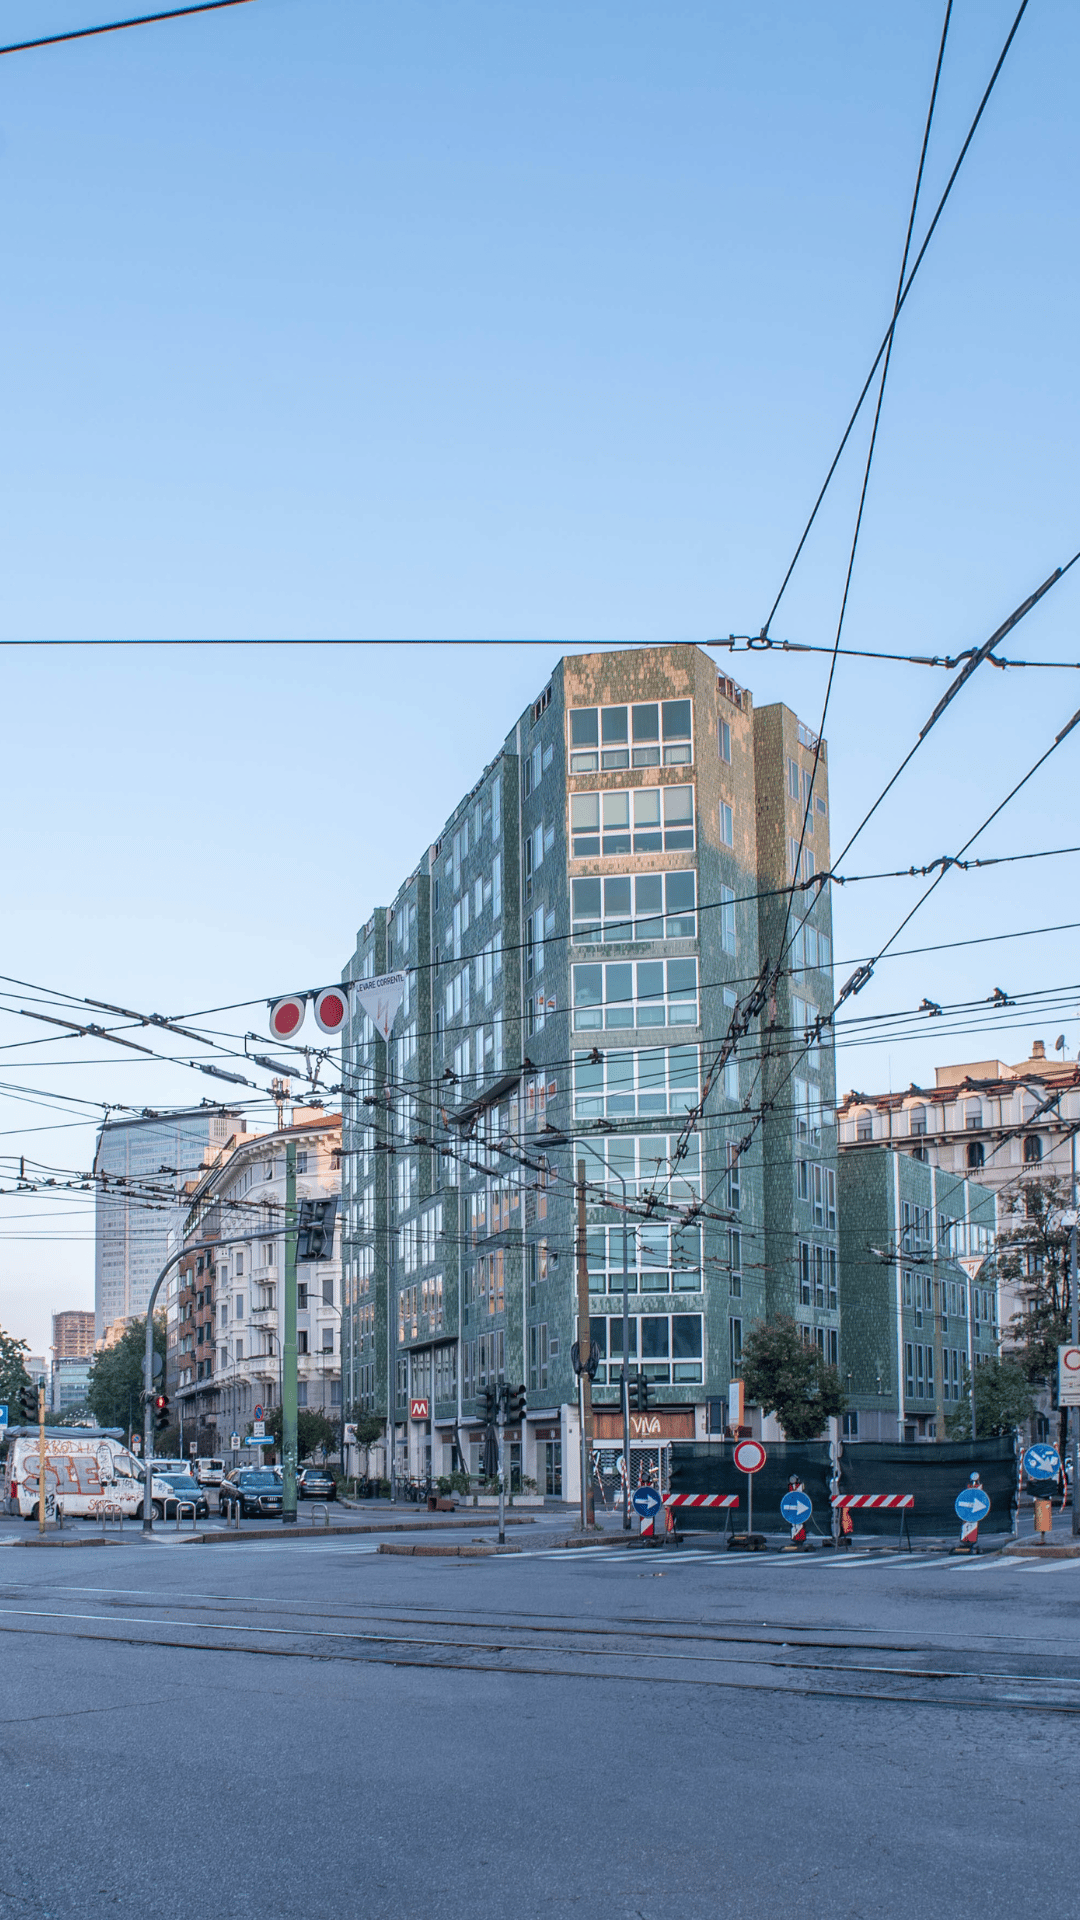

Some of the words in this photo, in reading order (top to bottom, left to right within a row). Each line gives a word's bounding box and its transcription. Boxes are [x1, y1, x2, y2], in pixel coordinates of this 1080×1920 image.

[356, 980, 376, 992] LEVARE
[412, 1402, 427, 1414] M
[630, 1416, 661, 1433] VIVA
